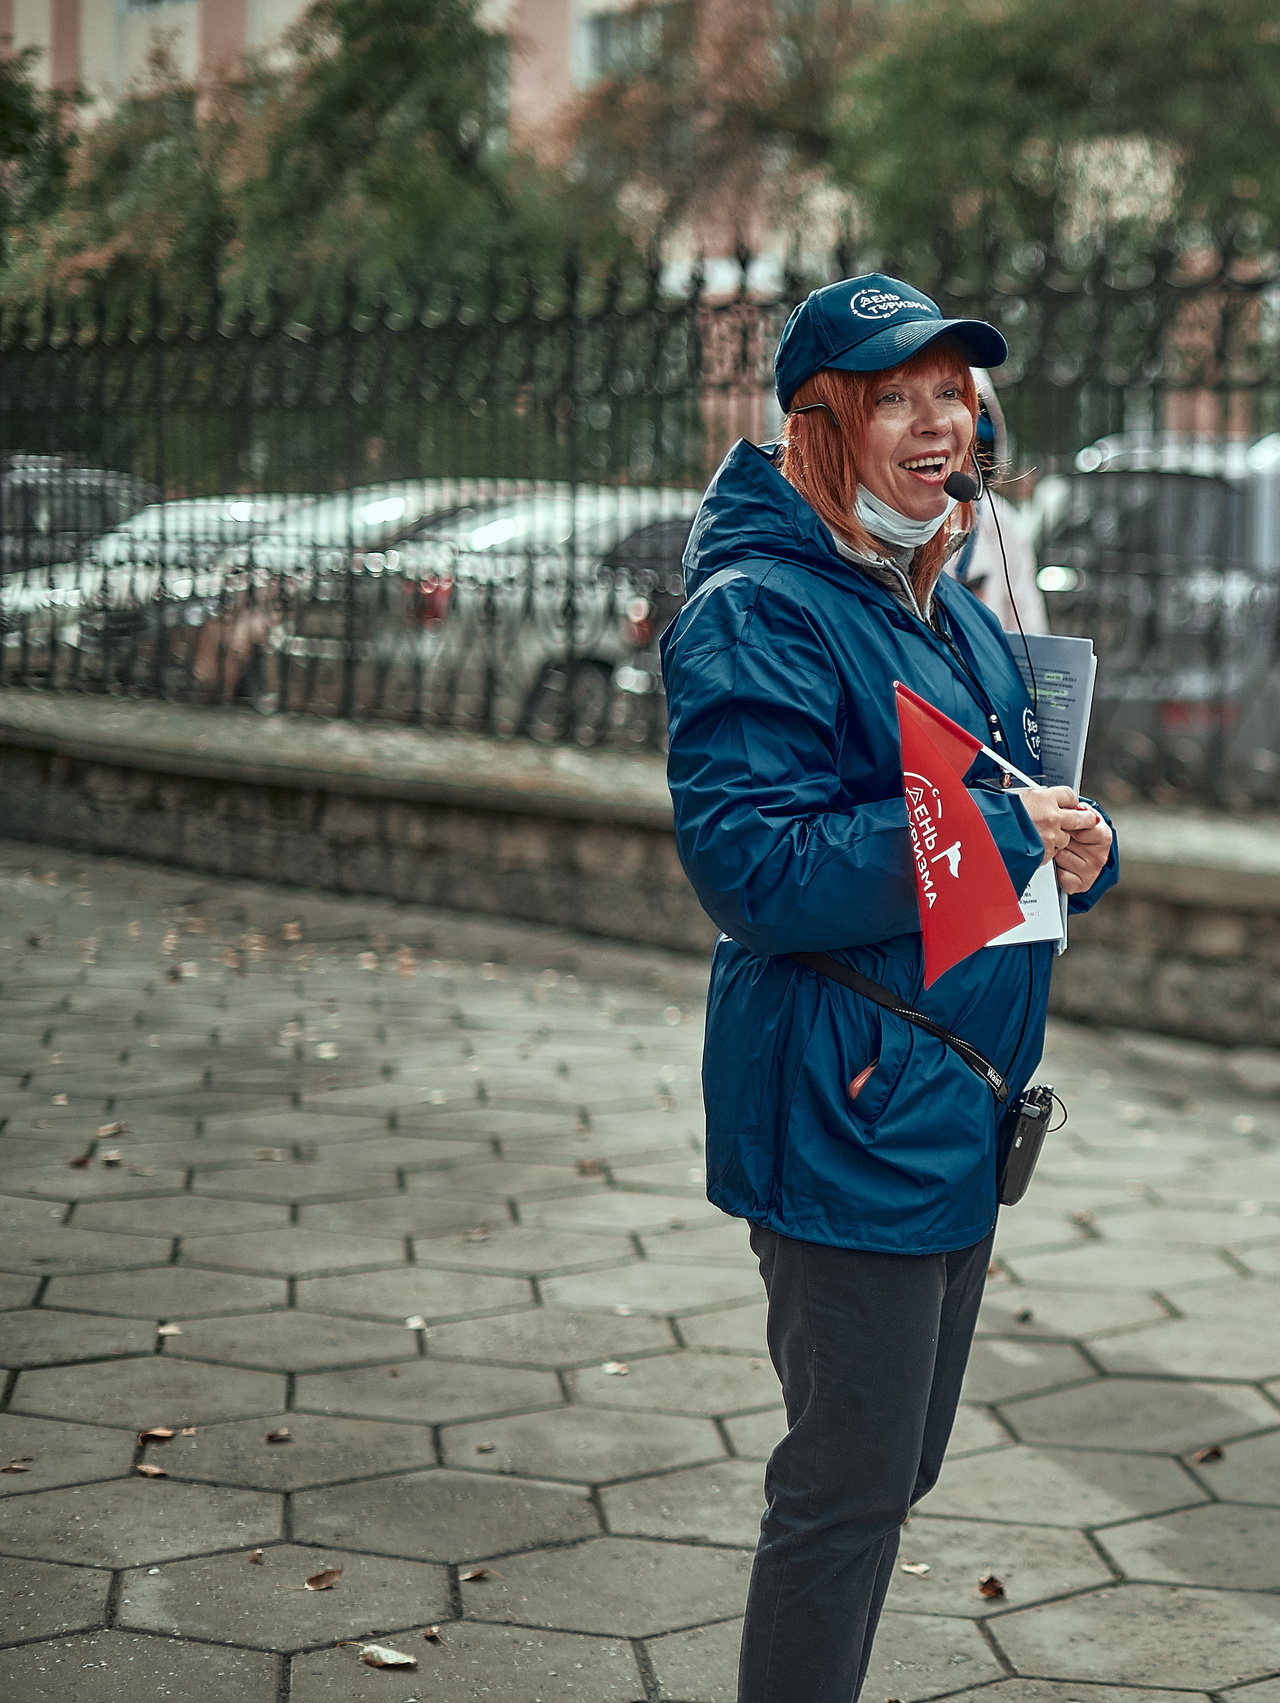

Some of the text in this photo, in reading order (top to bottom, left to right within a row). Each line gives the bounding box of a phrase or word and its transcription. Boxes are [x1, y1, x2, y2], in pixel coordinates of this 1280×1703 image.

[860, 293, 901, 308] ДЕНЬ
[867, 300, 933, 314] ТУРИЗМА
[905, 786, 938, 851] ДЕНЬ
